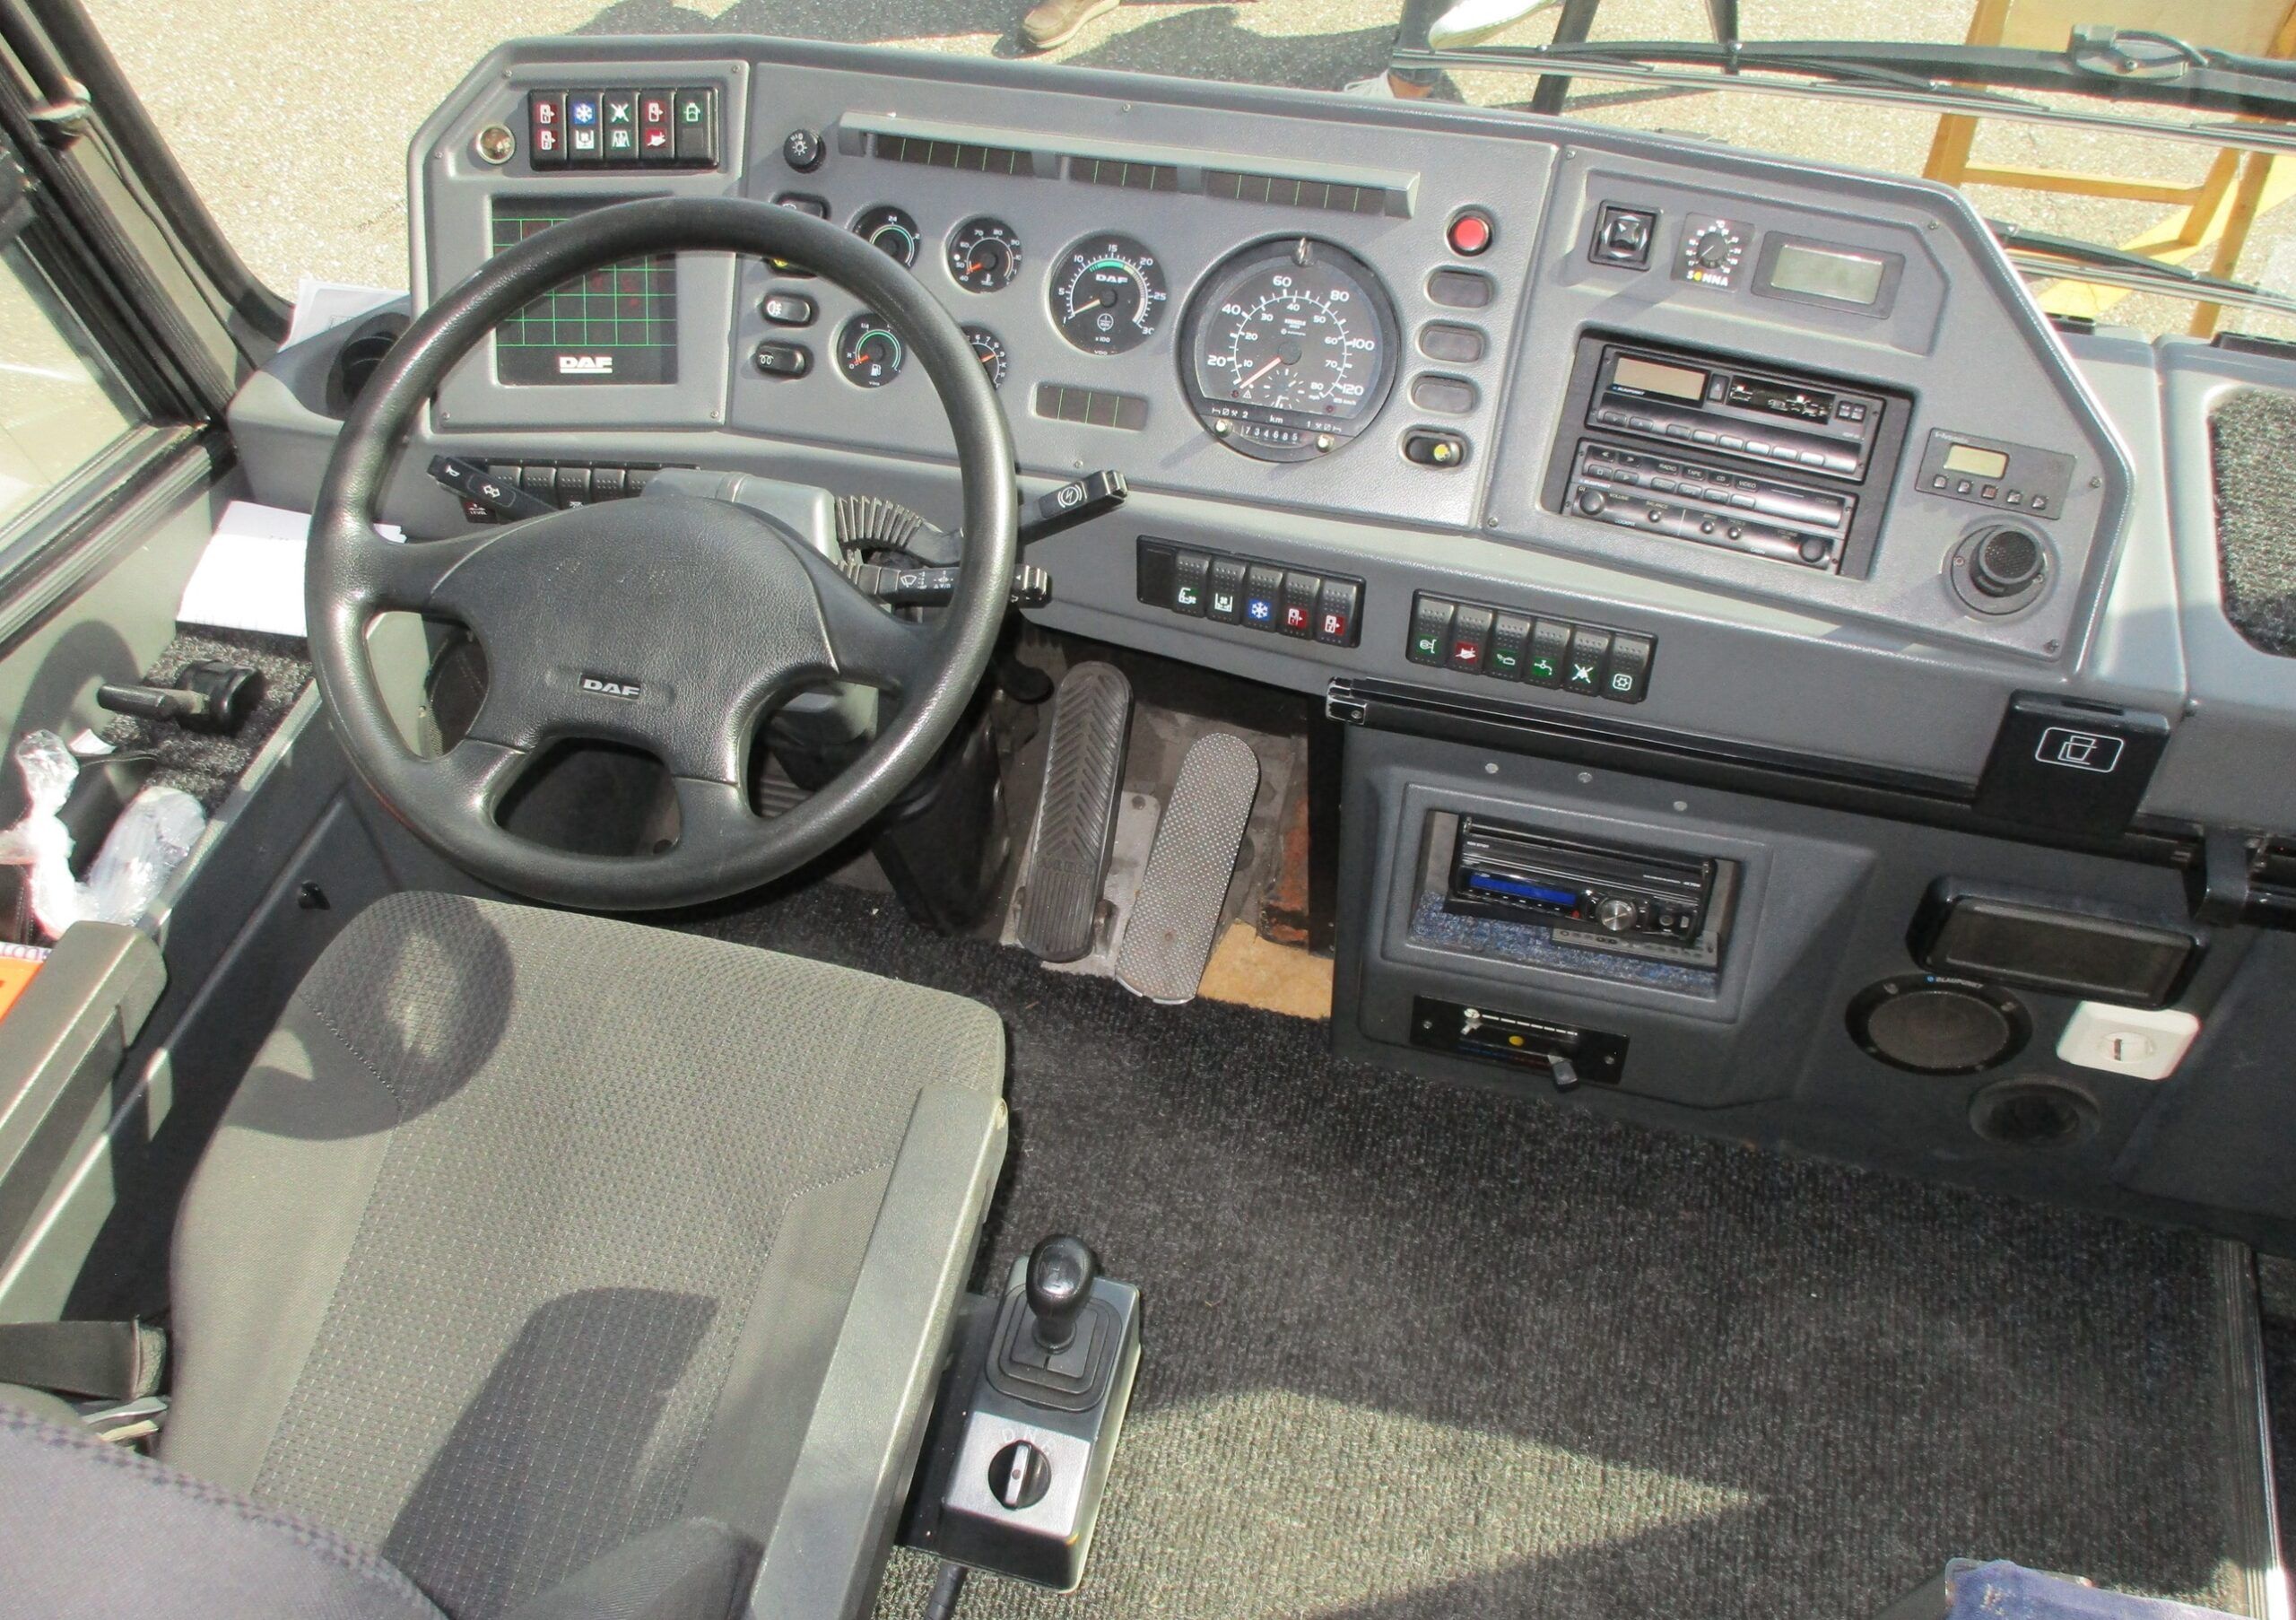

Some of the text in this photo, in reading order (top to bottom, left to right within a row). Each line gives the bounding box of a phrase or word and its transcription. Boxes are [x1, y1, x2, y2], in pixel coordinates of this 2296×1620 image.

[1108, 244, 1118, 252] 15
[1074, 255, 1083, 263] 10
[1140, 257, 1153, 266] 20
[1095, 274, 1128, 283] DAF
[1273, 275, 1292, 287] 60
[1153, 292, 1166, 300] 25
[1330, 290, 1349, 301] 80
[1222, 303, 1241, 316] 40
[1287, 303, 1300, 311] 40
[1261, 313, 1274, 321] 30
[1245, 332, 1258, 341] 20
[1325, 336, 1338, 344] 60
[1352, 338, 1375, 351] 100
[560, 357, 613, 370] DAF
[1207, 355, 1227, 367] 20
[1244, 360, 1253, 368] 10
[1325, 360, 1338, 368] 70
[1342, 384, 1364, 396] 120
[1242, 411, 1248, 419] 2
[1269, 414, 1283, 423] km
[583, 679, 639, 695] DAF
[1002, 1428, 1014, 1442] D
